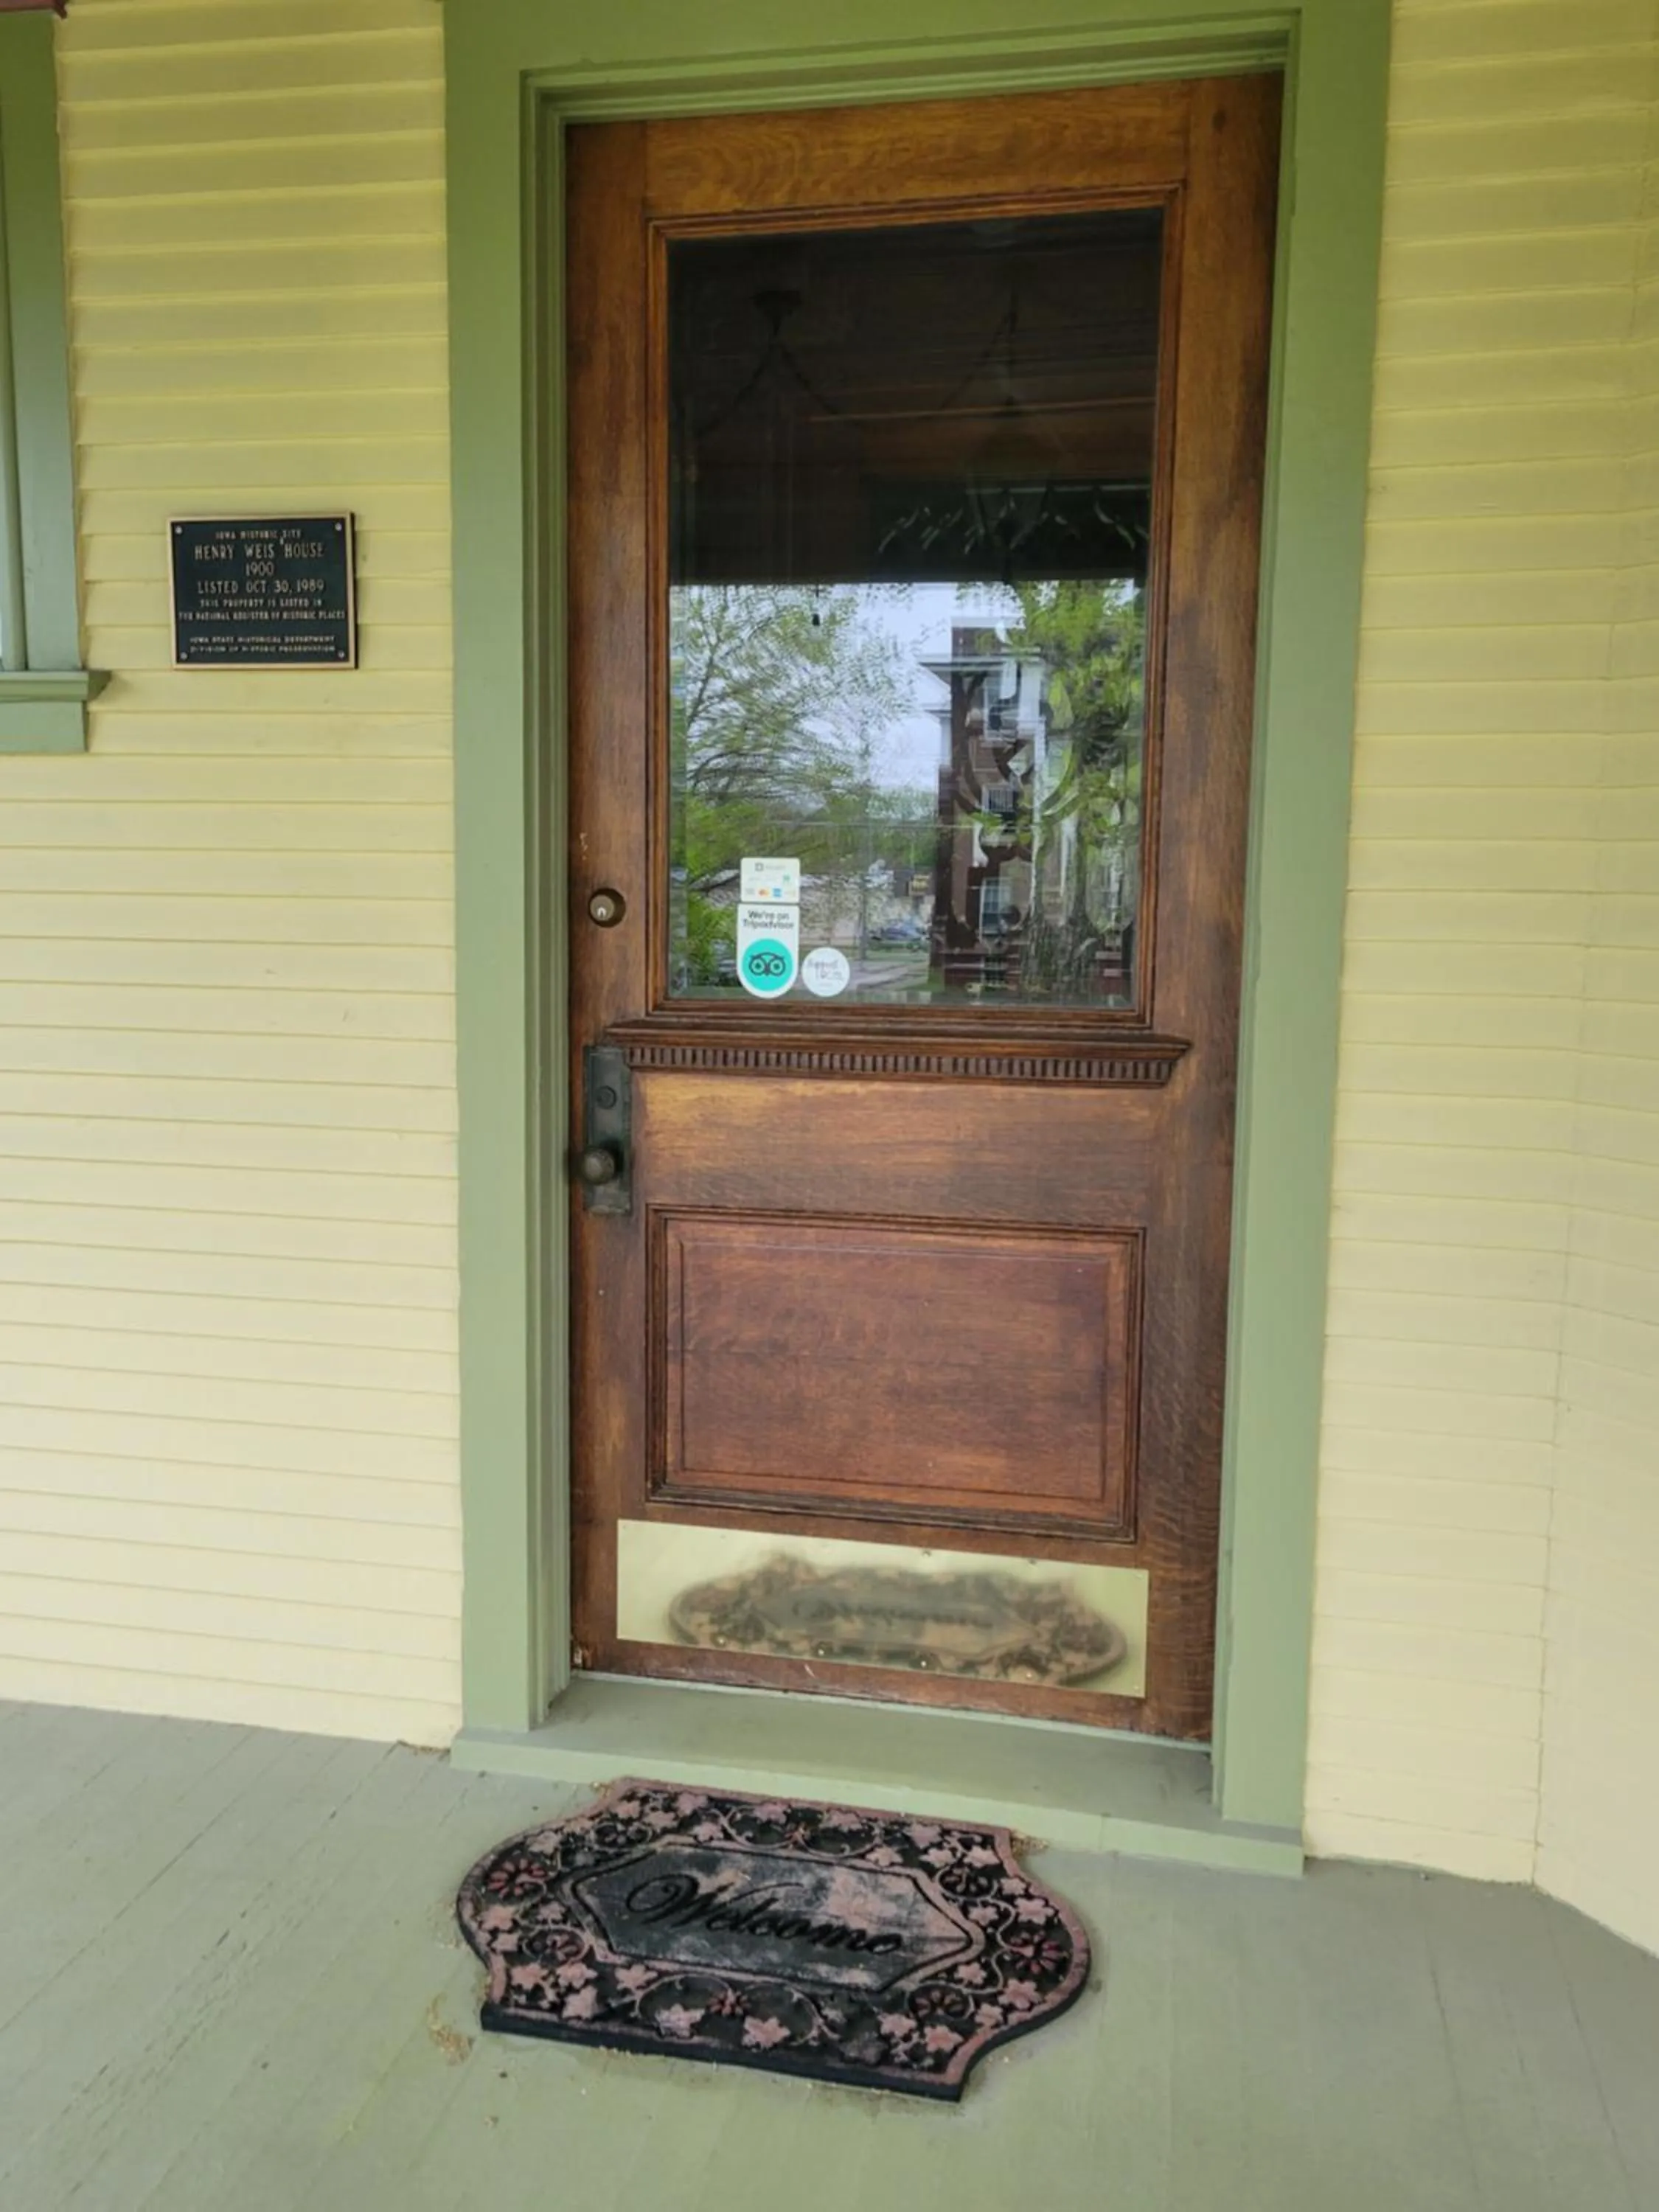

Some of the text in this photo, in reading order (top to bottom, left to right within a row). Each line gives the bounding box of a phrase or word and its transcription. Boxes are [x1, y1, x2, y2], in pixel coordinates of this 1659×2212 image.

[195, 543, 324, 560] HENRY WEIS HOUSE
[246, 561, 274, 577] 1900
[198, 580, 238, 594] LISTED
[274, 580, 292, 594] 30,
[296, 579, 324, 591] 1989
[201, 598, 321, 608] THIS PROPERTY IS LISTED IN
[195, 612, 230, 620] NATIONAL
[233, 611, 270, 620] REGISTER
[271, 611, 280, 620] OF
[282, 611, 316, 620] HISTORIC
[319, 611, 345, 619] PLACES
[748, 910, 774, 919] We're
[742, 919, 794, 929] Tripadvisor
[627, 1874, 903, 1954] Welcome
